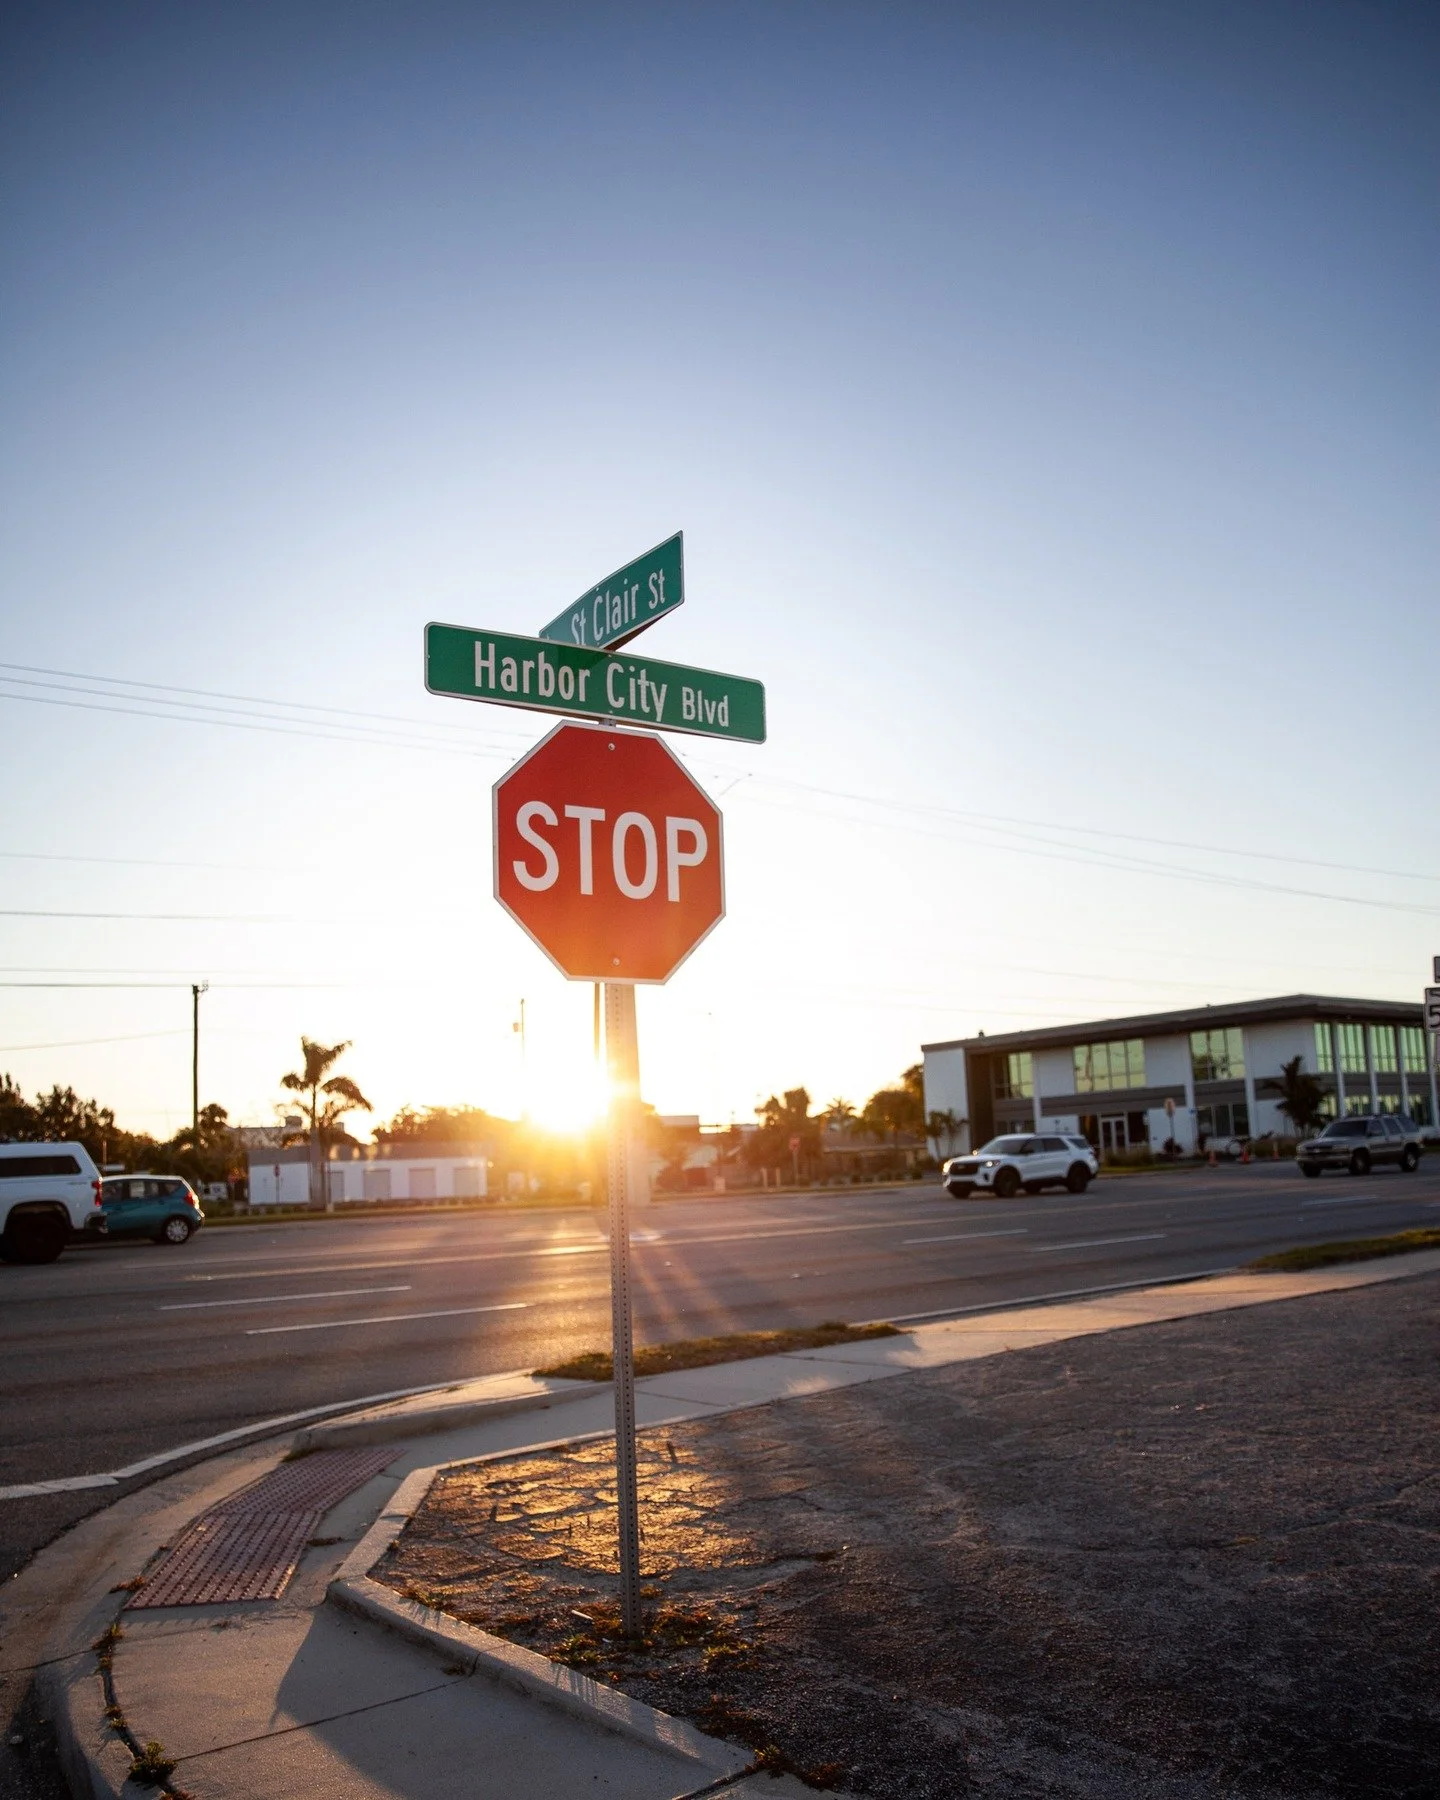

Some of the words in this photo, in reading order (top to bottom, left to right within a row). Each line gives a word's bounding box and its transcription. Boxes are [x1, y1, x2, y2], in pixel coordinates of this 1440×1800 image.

[571, 608, 587, 646] St
[593, 578, 639, 641] Clair
[648, 568, 666, 609] St
[474, 641, 590, 702] Harbor
[606, 662, 668, 722] City
[681, 686, 730, 728] Blvd
[512, 800, 708, 902] STOP
